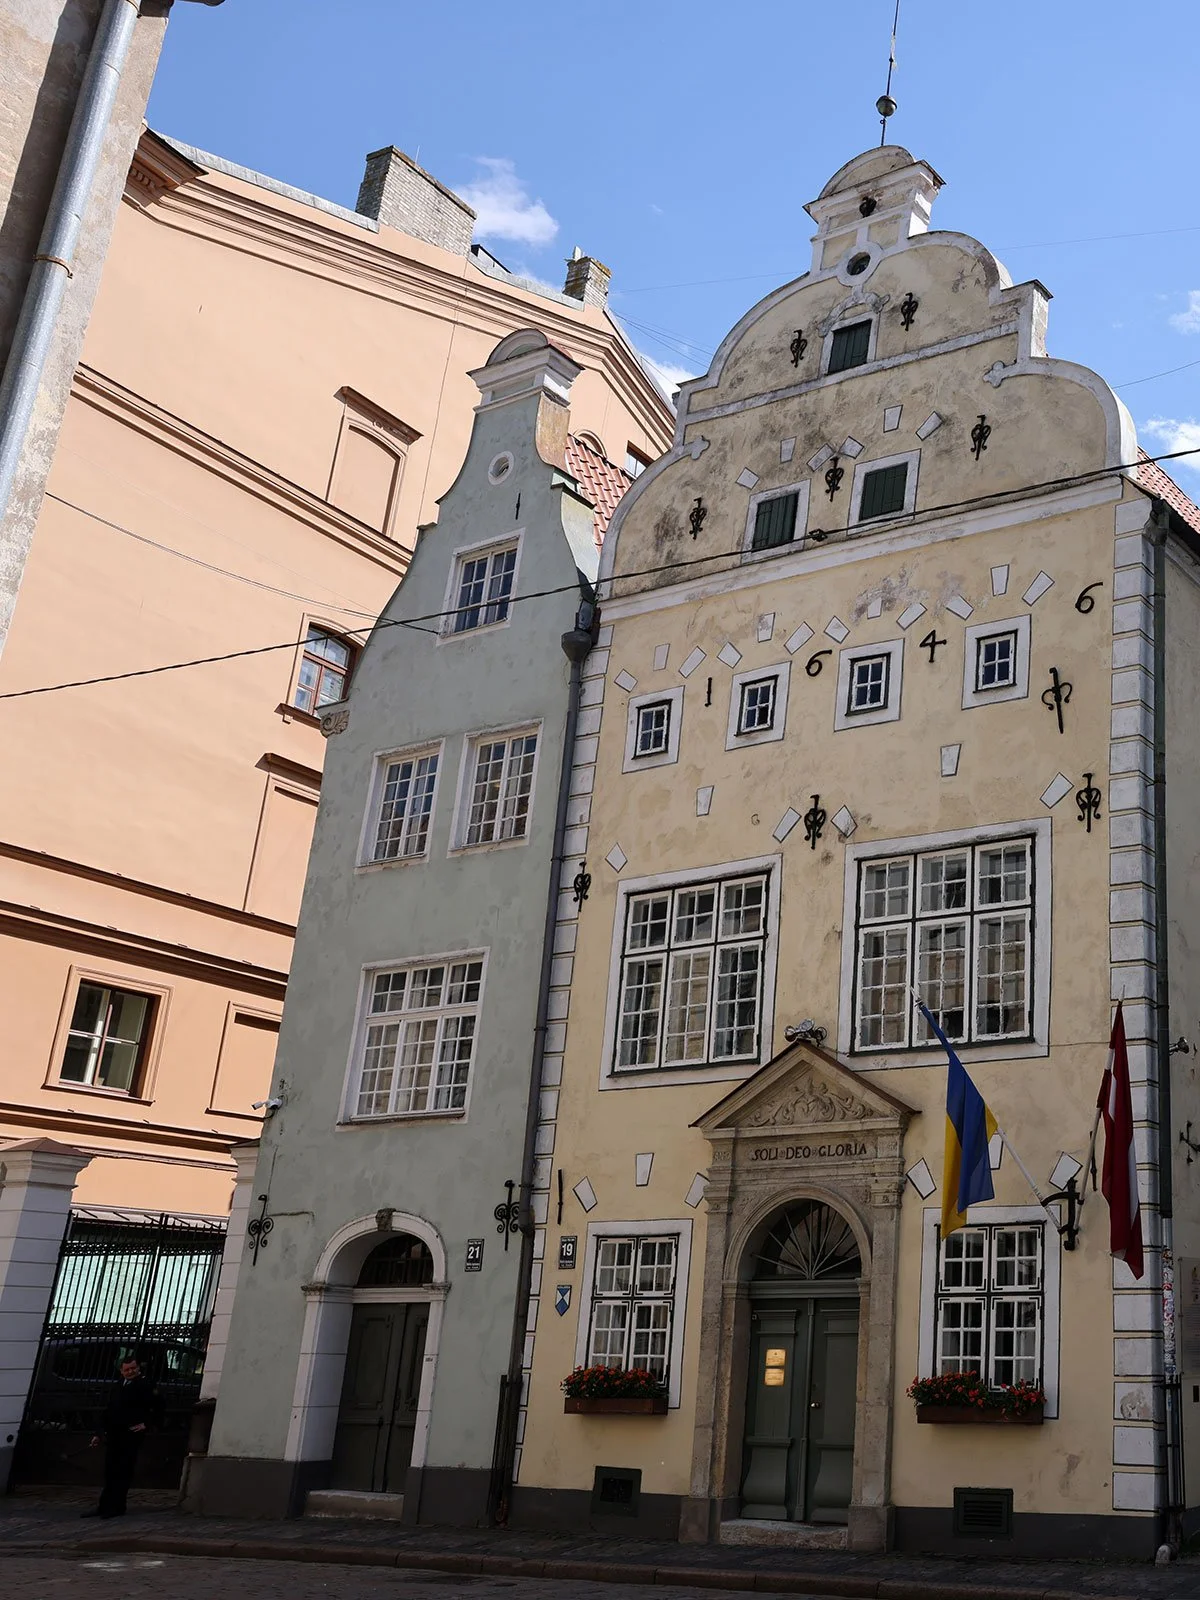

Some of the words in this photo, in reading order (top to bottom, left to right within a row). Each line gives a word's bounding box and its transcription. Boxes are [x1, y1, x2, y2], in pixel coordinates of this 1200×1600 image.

[751, 1148, 779, 1161] SOLI
[785, 1146, 811, 1160] DEO
[818, 1143, 867, 1157] GLORIA
[468, 1246, 480, 1259] 21
[562, 1243, 573, 1256] 19
